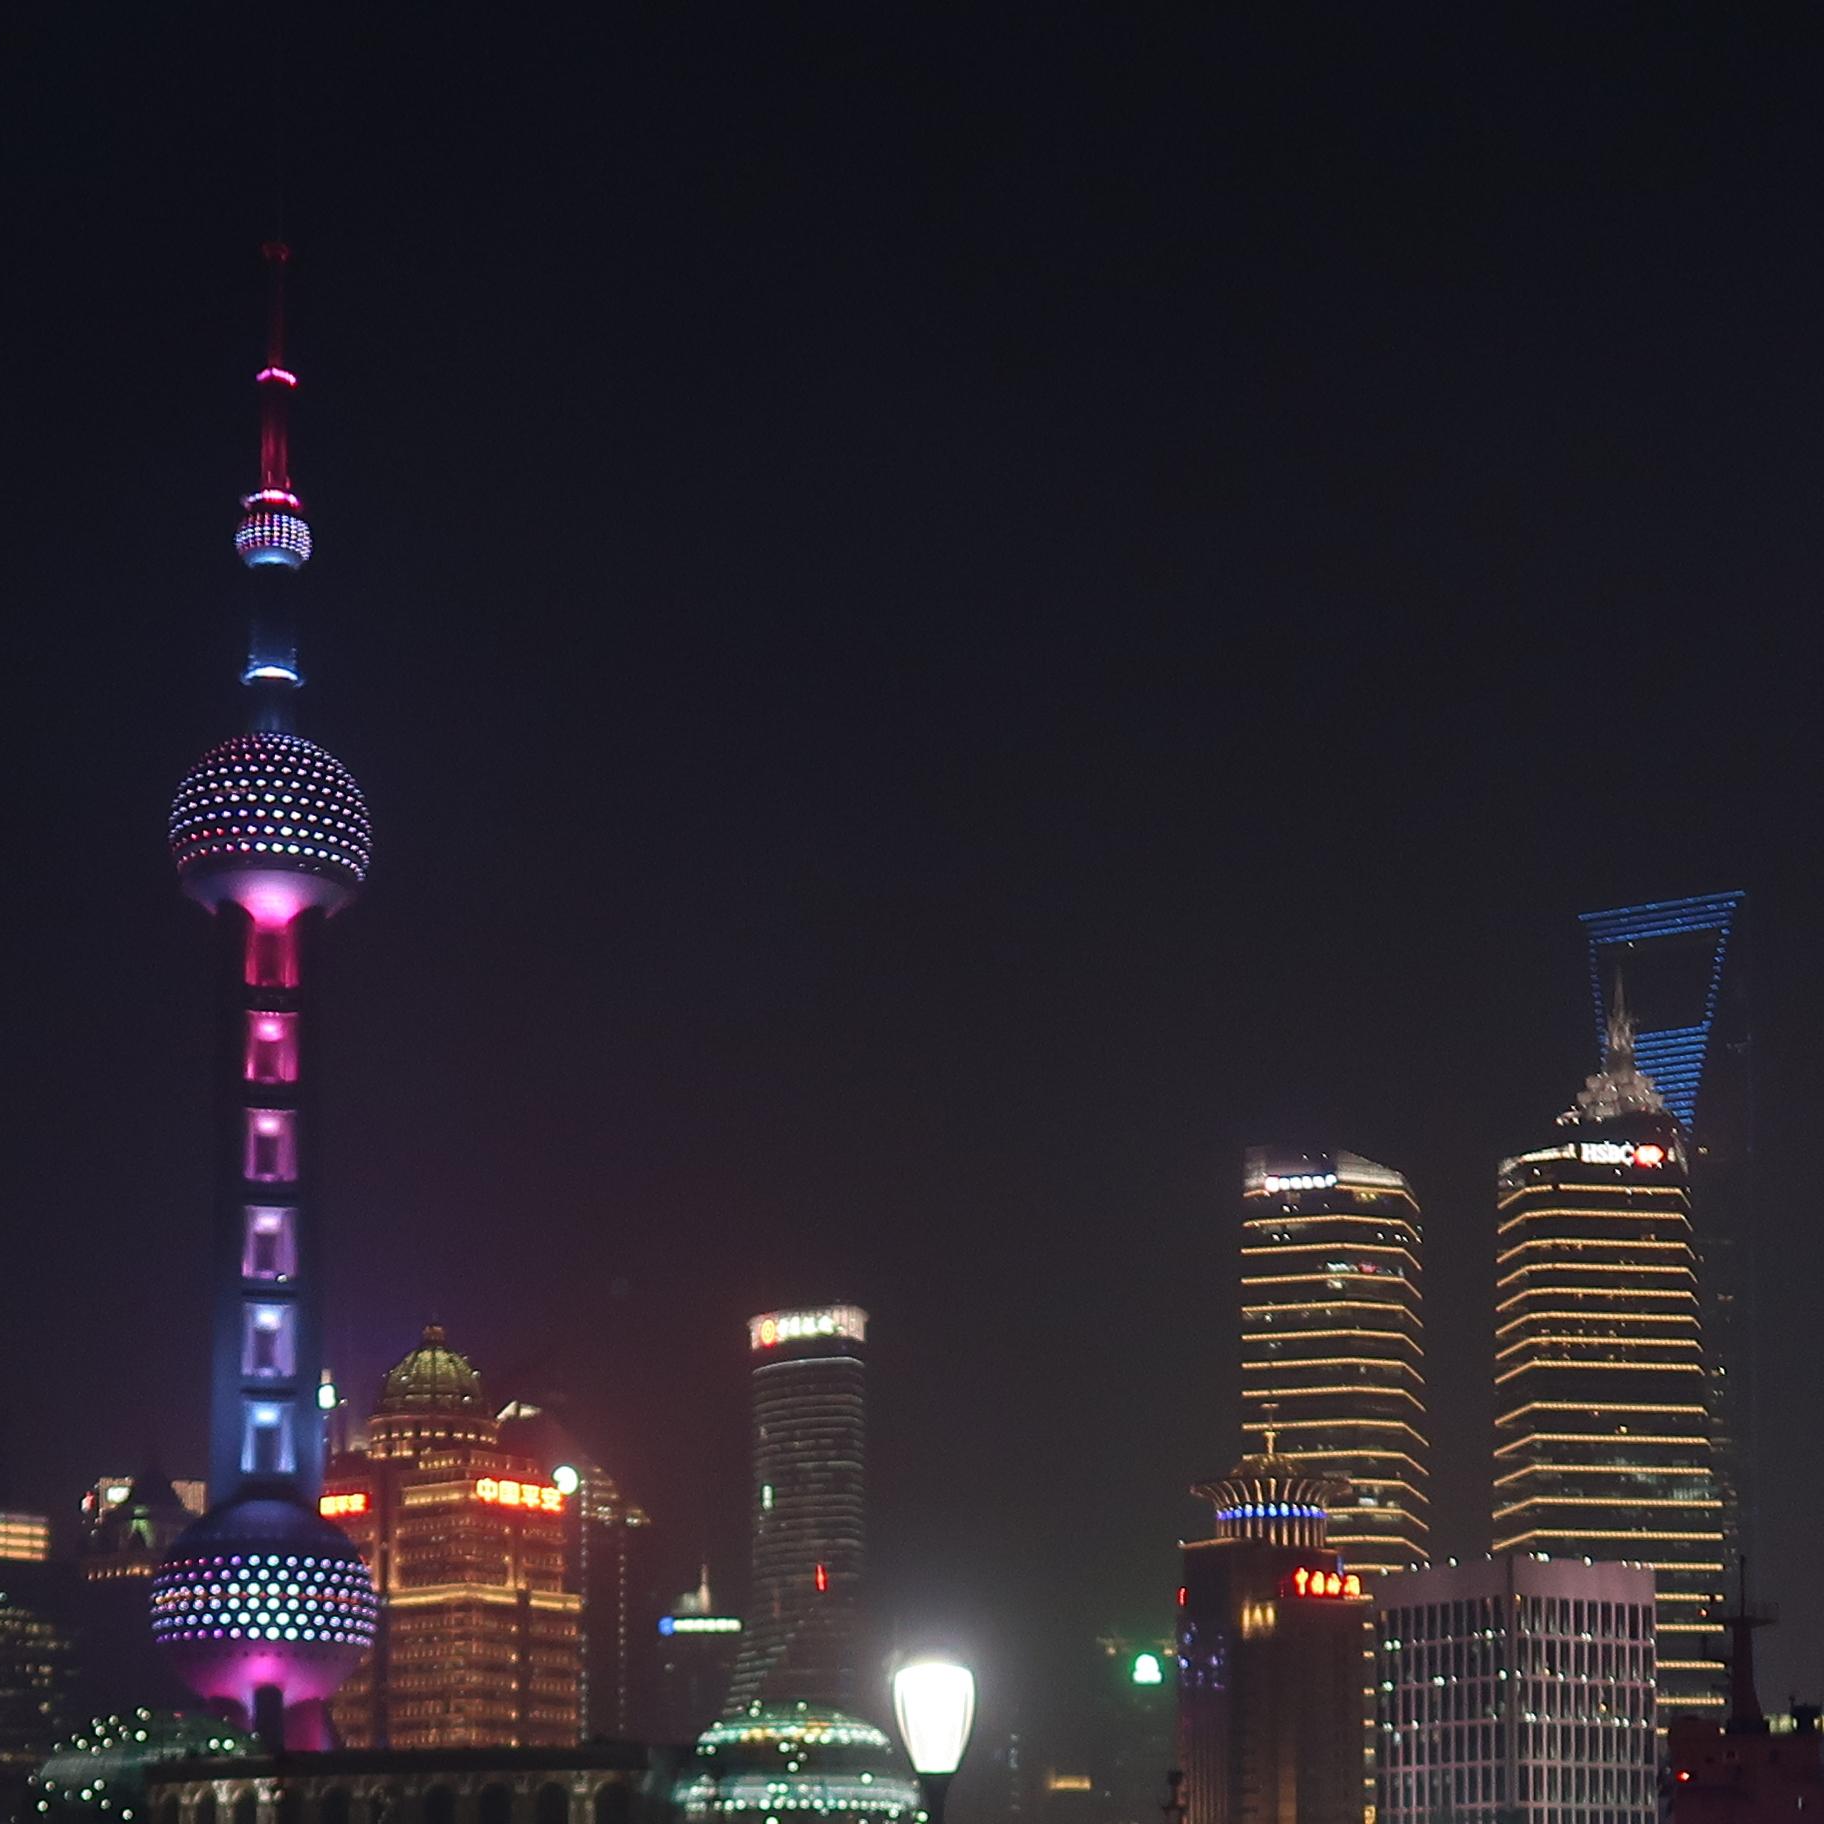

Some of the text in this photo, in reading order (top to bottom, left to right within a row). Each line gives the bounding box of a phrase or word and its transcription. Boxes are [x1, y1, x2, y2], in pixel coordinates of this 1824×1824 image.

[1580, 1141, 1635, 1165] HSBC
[476, 1477, 564, 1514] 中国平安
